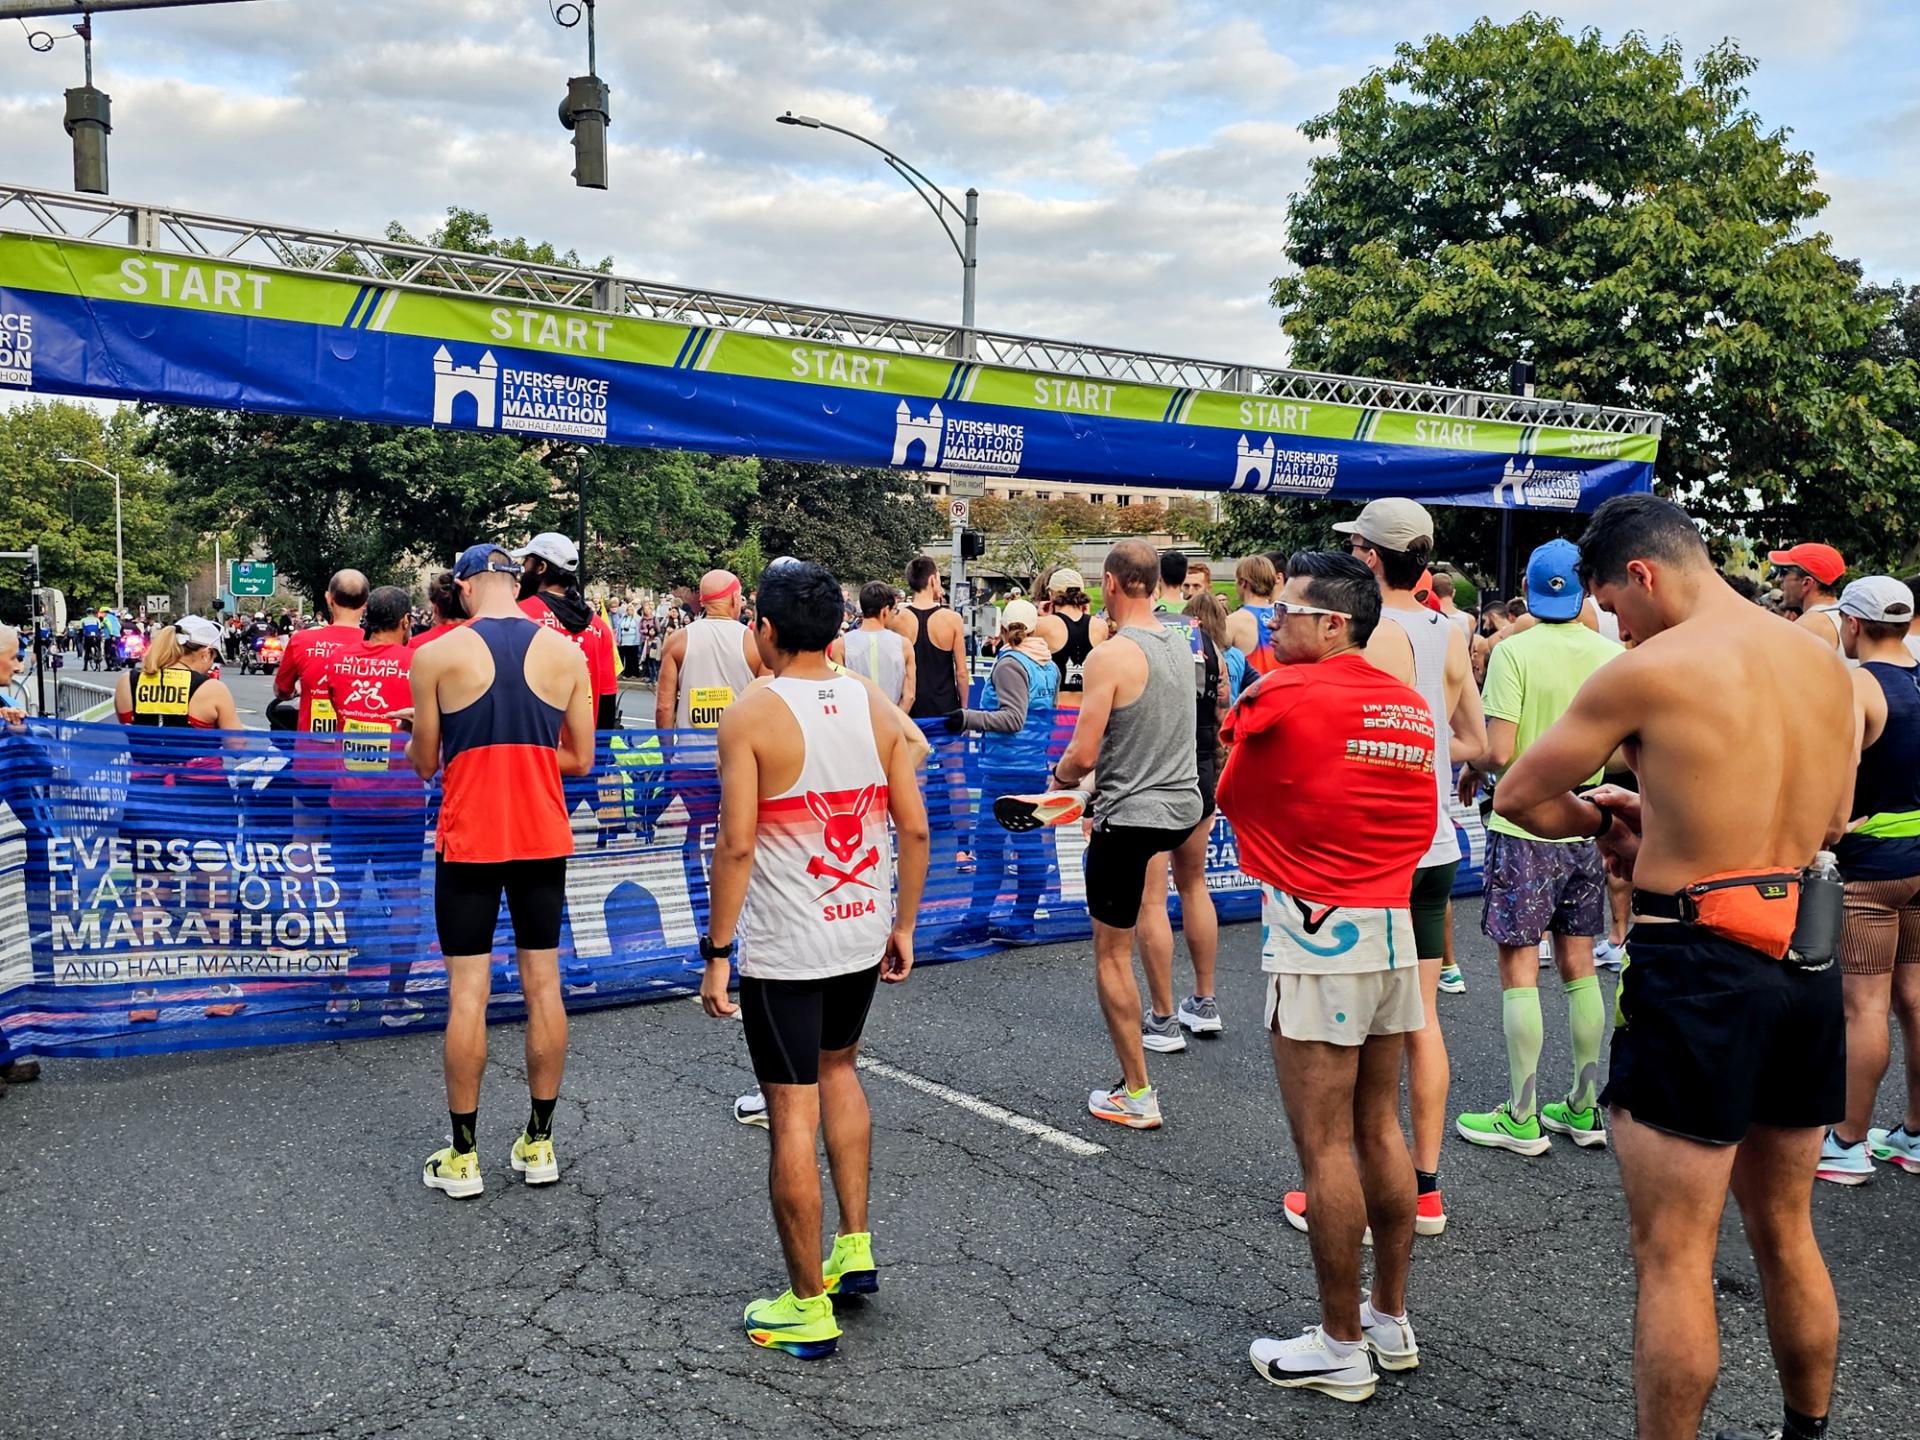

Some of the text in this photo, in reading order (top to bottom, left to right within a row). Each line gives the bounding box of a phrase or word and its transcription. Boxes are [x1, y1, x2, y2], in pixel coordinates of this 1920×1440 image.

[119, 258, 272, 310] START
[490, 307, 614, 353] START
[791, 347, 890, 386] START
[503, 368, 609, 395] EVERSOURCE
[503, 384, 607, 409] HARTFORD
[1034, 377, 1117, 412] START
[502, 400, 607, 424] MARATHON
[1240, 401, 1312, 431] START
[504, 418, 604, 436] AND HALF MARATHON
[946, 418, 1024, 439] EVERSOURCE
[1415, 419, 1477, 448] START
[945, 432, 1024, 451] HARTFORD
[1569, 433, 1622, 457] START
[943, 445, 1022, 464] MARATHON
[1276, 450, 1339, 466] EVERSOURCE
[959, 462, 977, 470] HALF
[978, 464, 1017, 473] MARATHON
[1275, 461, 1337, 477] HARTFORD
[1272, 472, 1335, 488] MARATHON
[1524, 486, 1581, 499] MARATHON
[239, 577, 266, 585] Waterbury
[333, 663, 410, 680] TRIUMPH
[343, 656, 399, 668] MYTEAM
[138, 684, 188, 704] GUIDE
[48, 837, 336, 873] EVERSOURCE
[50, 873, 341, 911] HARTFORD
[823, 898, 877, 922] SUB4
[51, 911, 347, 951] MARATHON
[62, 954, 341, 981] AND HALF MARATHON
